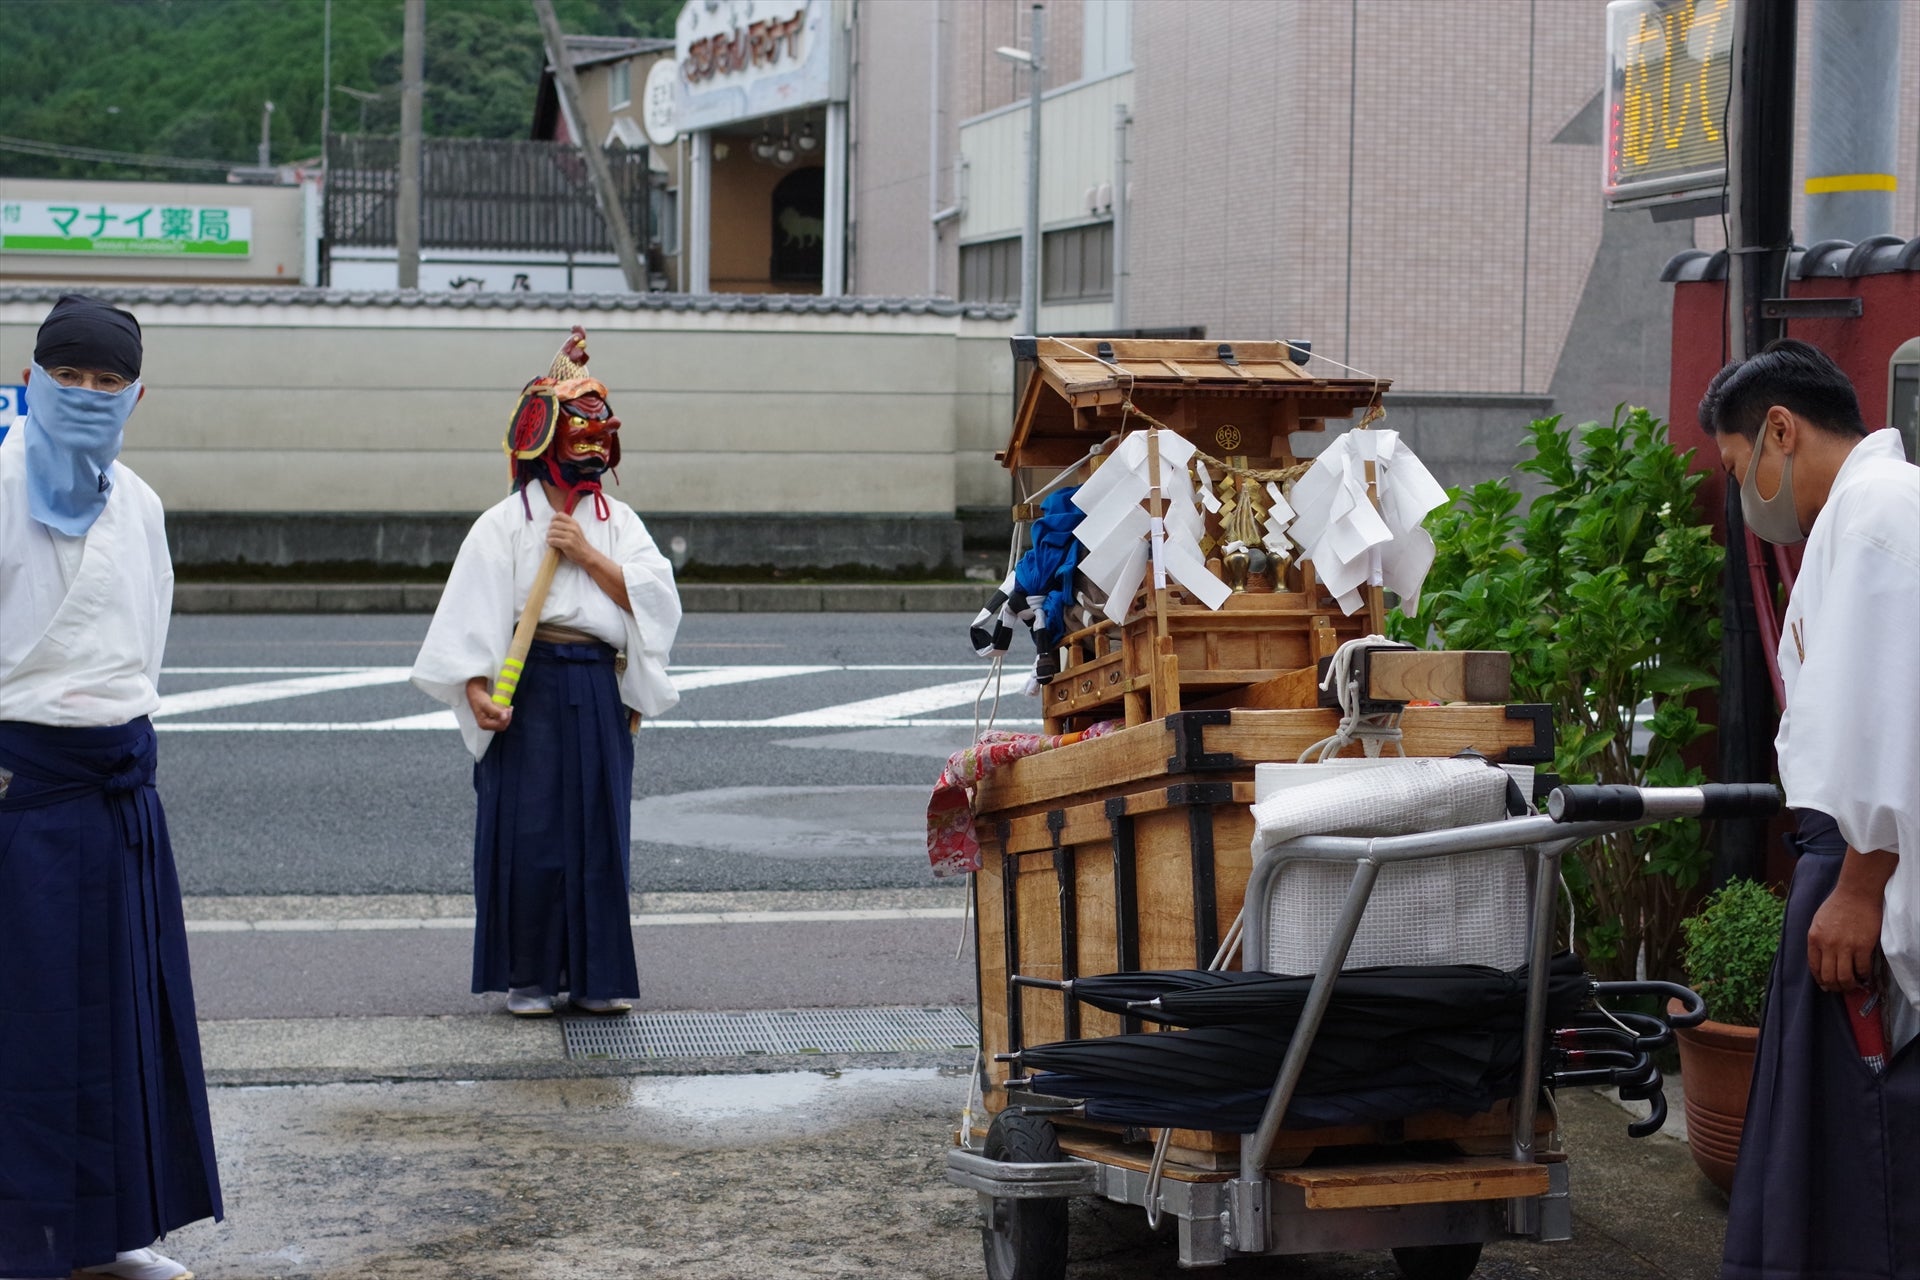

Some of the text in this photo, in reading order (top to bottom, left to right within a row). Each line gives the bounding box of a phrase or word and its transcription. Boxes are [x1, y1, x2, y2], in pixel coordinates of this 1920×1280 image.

[47, 206, 230, 241] マナイ薬局
